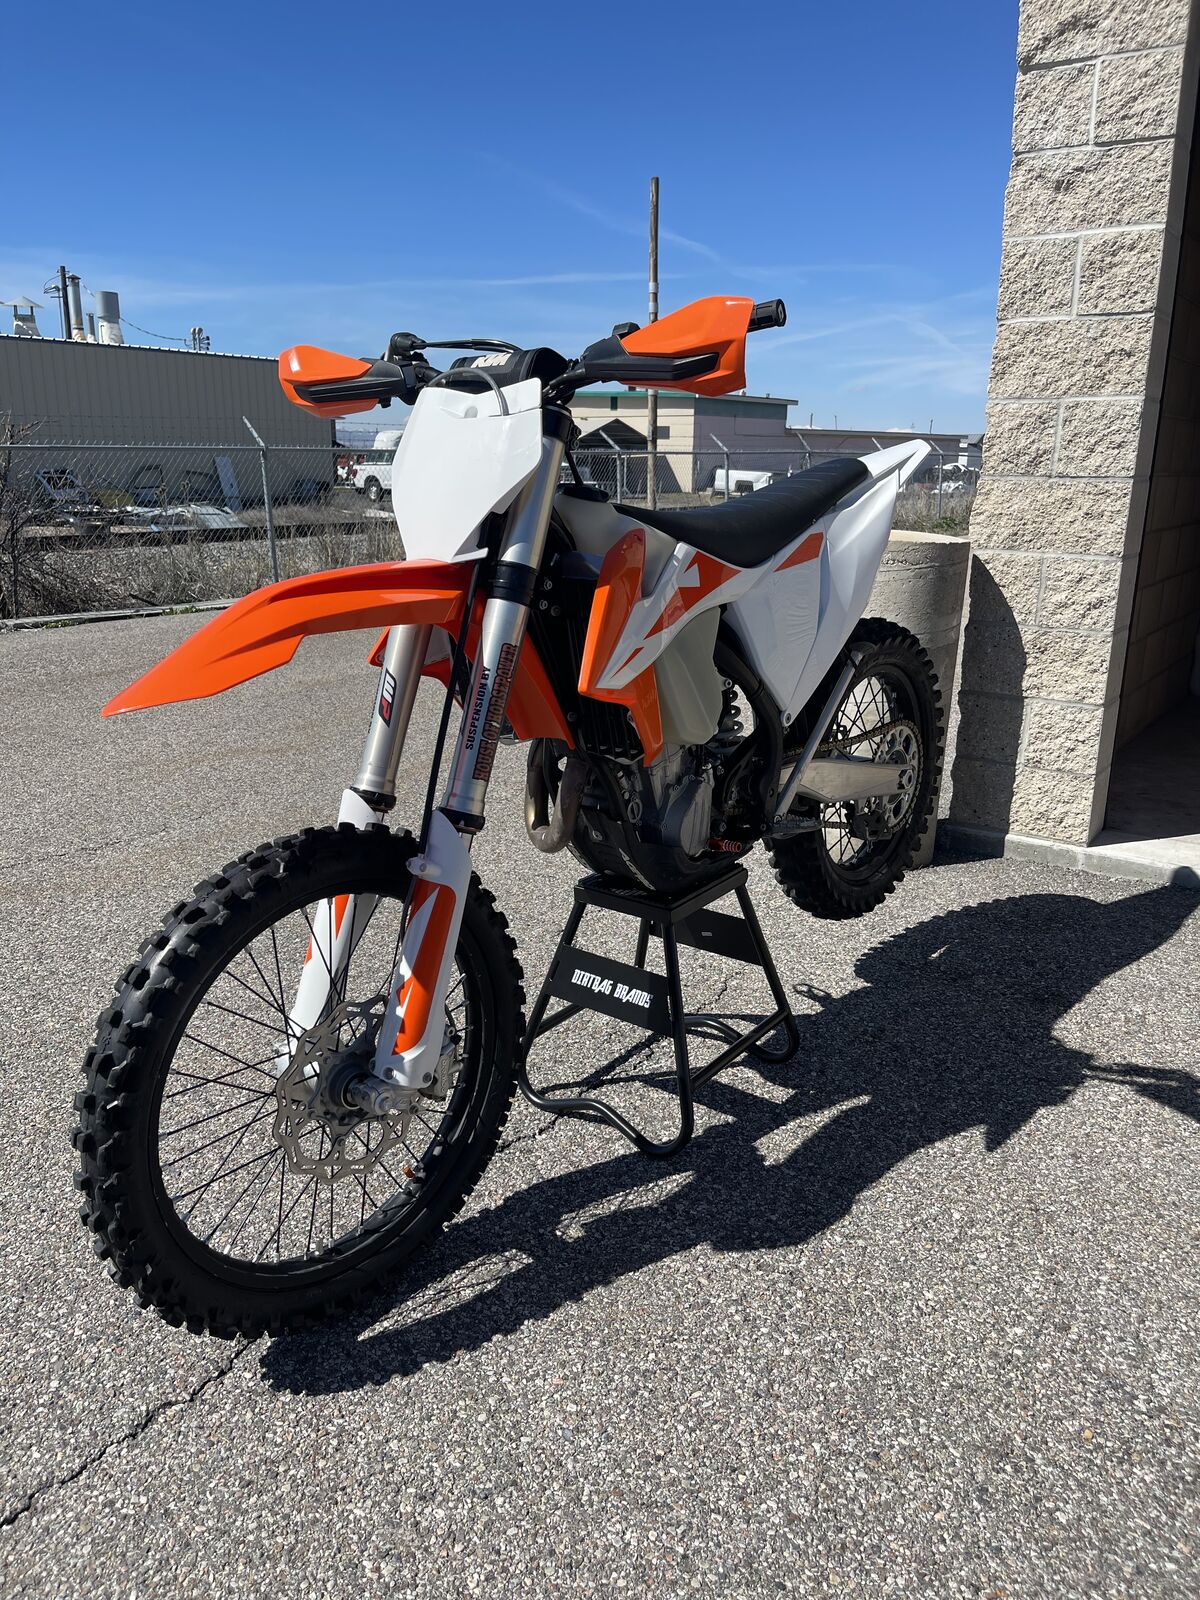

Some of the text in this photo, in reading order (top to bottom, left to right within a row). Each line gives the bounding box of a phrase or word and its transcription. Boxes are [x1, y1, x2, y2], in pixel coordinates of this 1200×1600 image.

[466, 666, 492, 750] SUSPENSION BY
[473, 643, 518, 781] HOUSE OF HORSEPOWER
[571, 969, 651, 1009] DIRTBAG BRANDS
